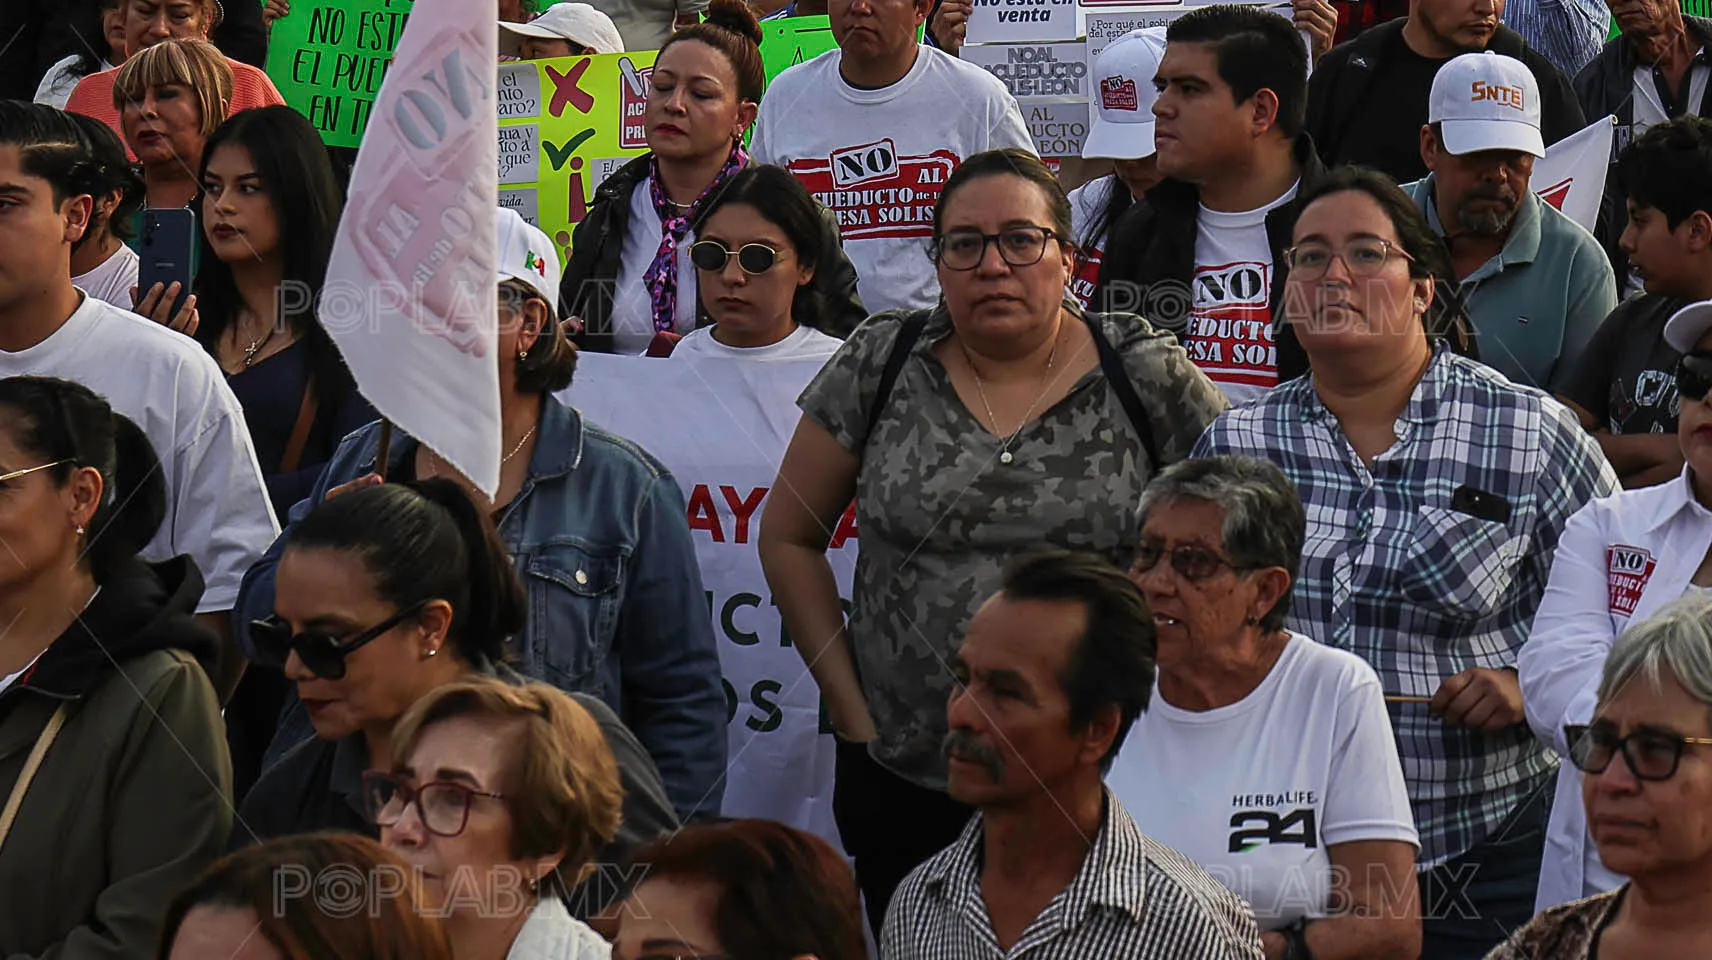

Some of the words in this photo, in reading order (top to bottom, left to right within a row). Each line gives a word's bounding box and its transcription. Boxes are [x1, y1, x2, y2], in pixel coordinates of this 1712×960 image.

[307, 7, 345, 45] NO
[998, 8, 1051, 22] venta
[1137, 19, 1147, 28] el
[292, 49, 321, 85] EL
[310, 96, 342, 132] EN
[1031, 107, 1054, 121] AL
[837, 147, 892, 181] NO
[917, 168, 944, 184] AL
[878, 206, 934, 223] SOLIS
[1197, 269, 1261, 304] NO
[1615, 552, 1642, 568] NO
[1232, 791, 1314, 807] HERBALIFE
[1228, 809, 1317, 853] 24
